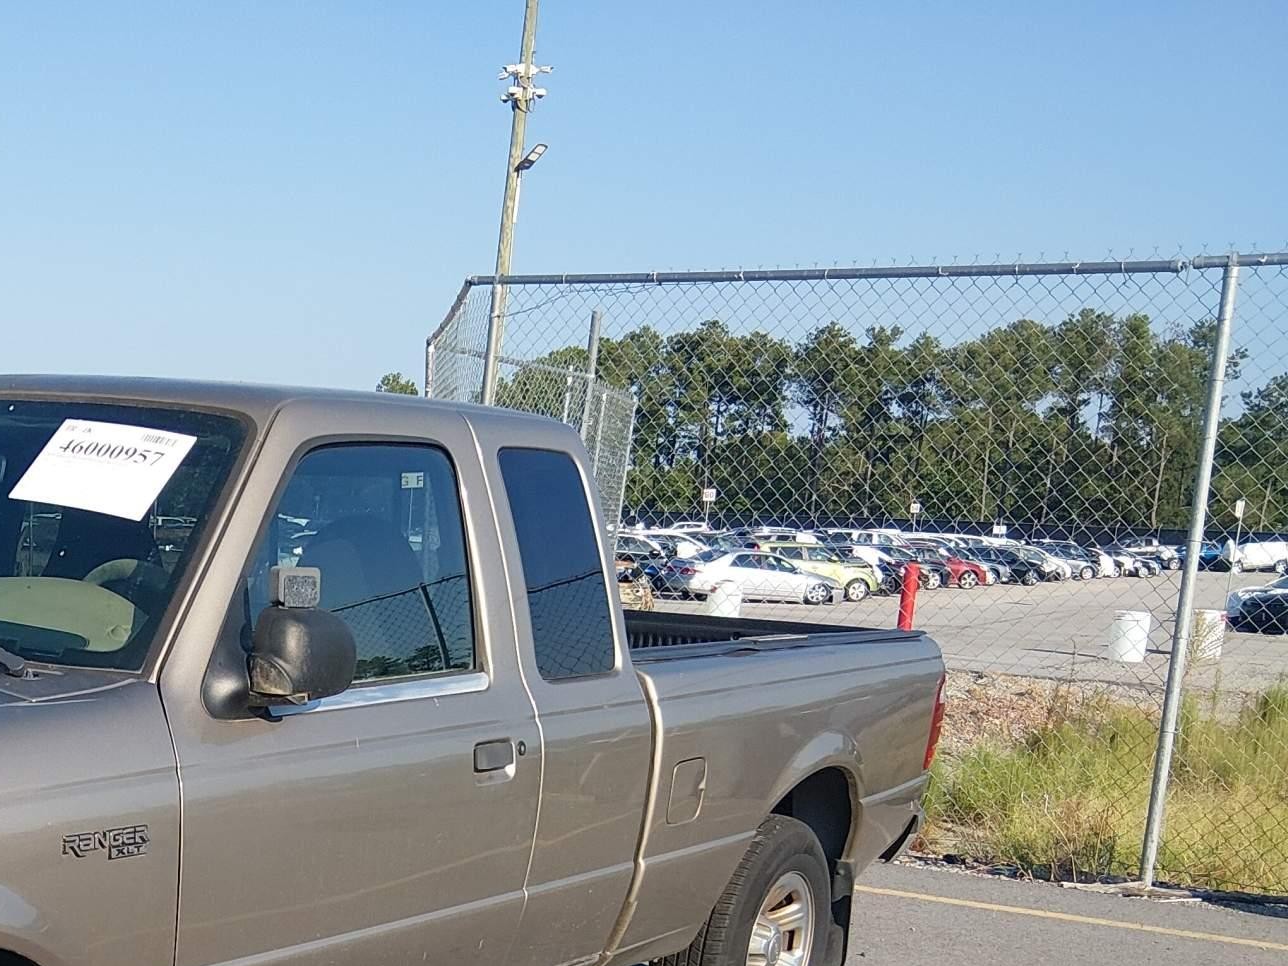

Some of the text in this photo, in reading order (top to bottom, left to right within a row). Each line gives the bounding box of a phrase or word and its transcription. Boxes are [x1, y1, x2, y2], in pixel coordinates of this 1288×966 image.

[59, 439, 166, 466] 46000957
[62, 824, 150, 858] RANGER
[115, 844, 143, 857] XLT
